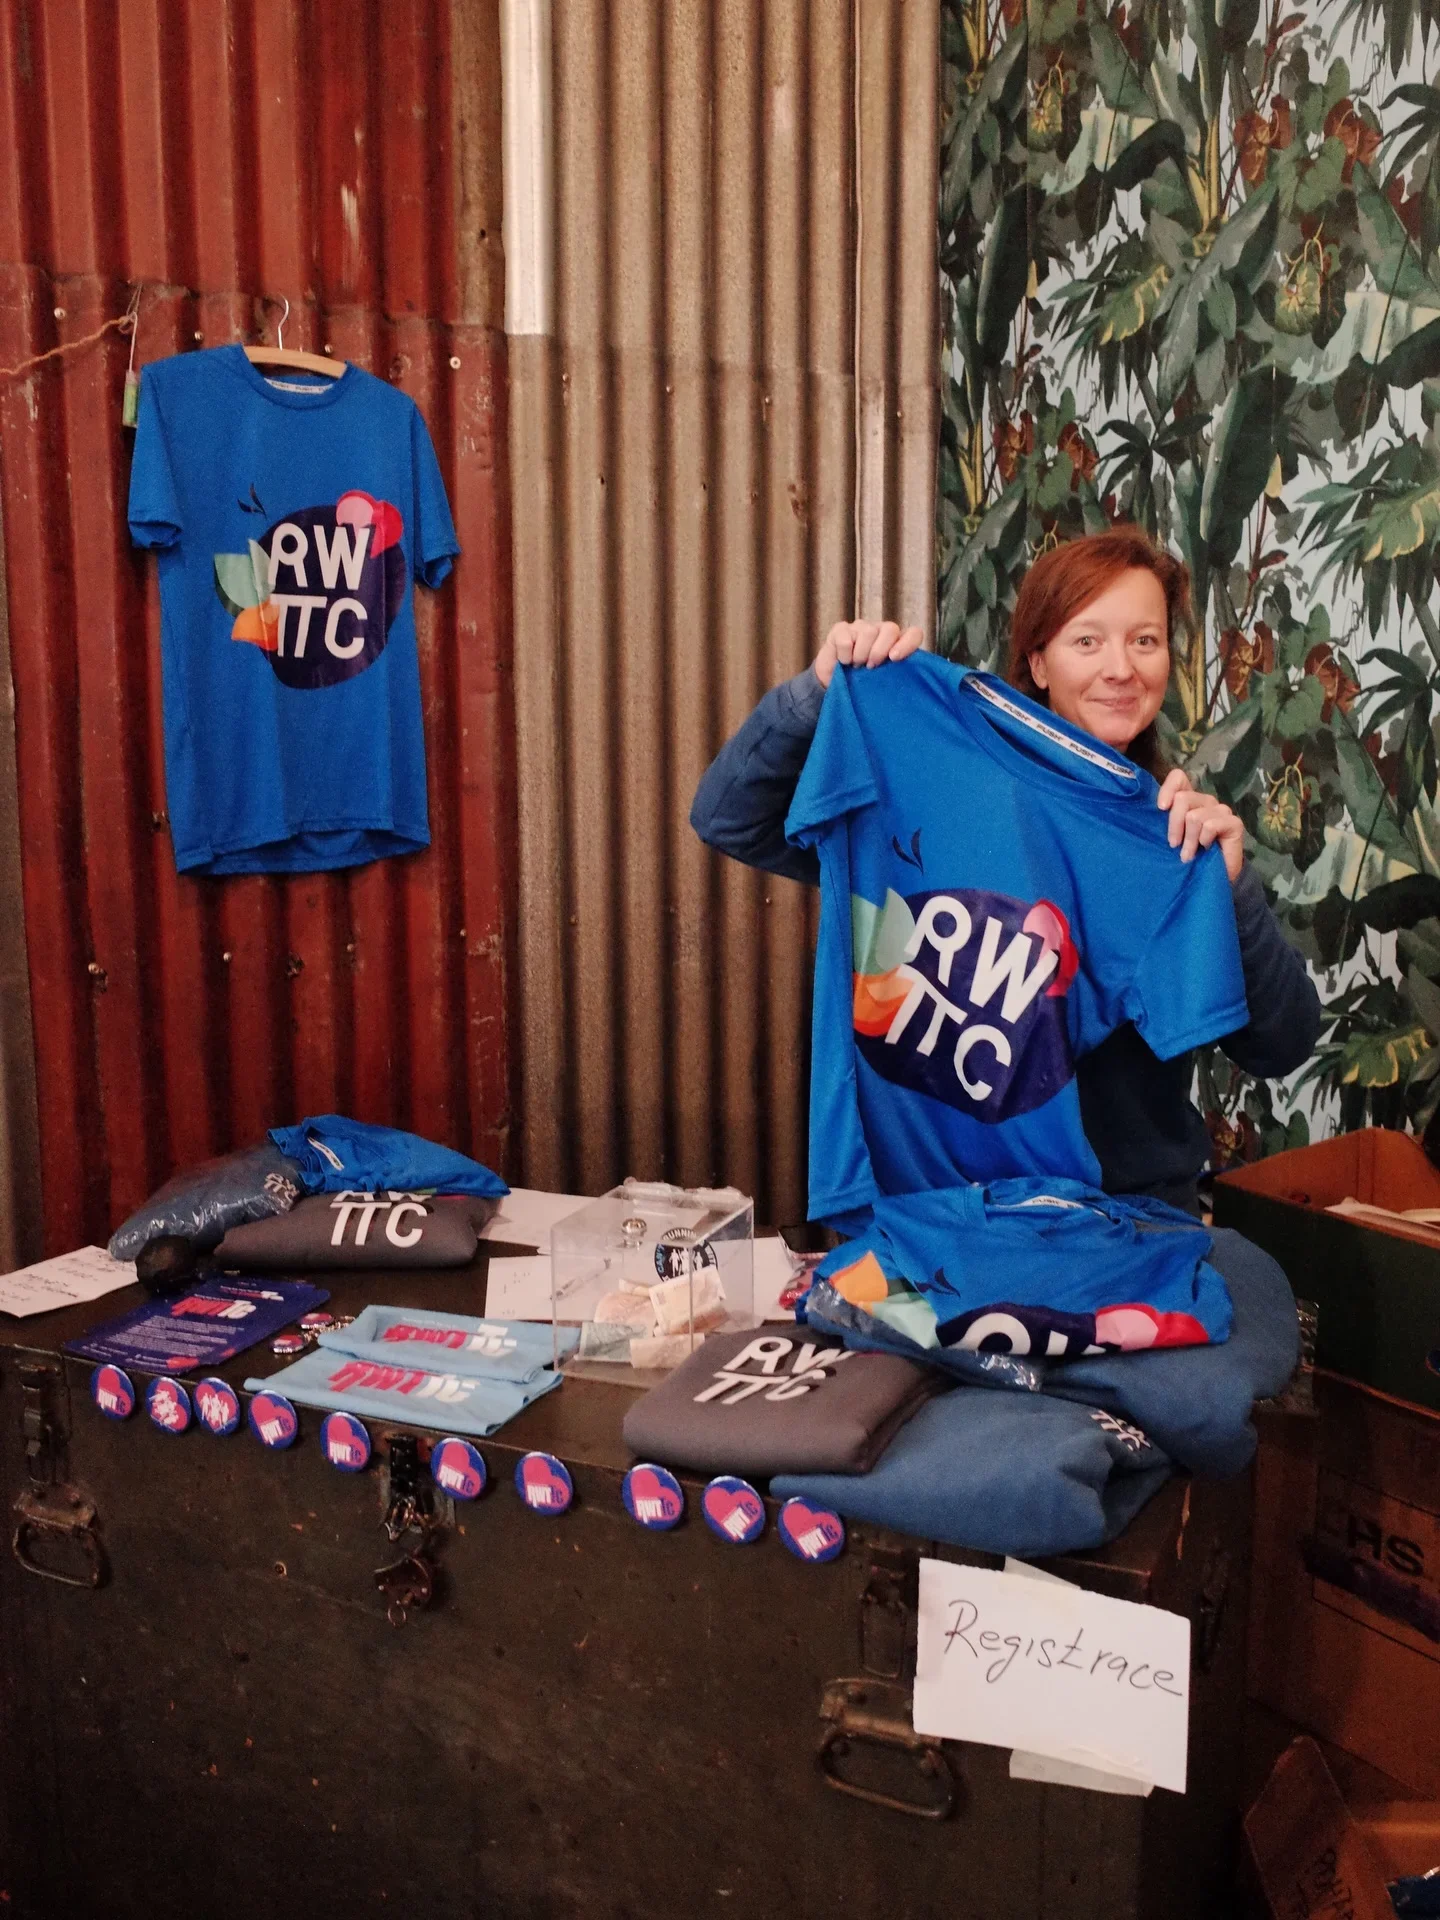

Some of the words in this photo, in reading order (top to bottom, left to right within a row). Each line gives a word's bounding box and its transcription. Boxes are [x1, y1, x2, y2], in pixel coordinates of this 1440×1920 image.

[267, 522, 371, 591] RW
[1003, 702, 1031, 722] PUSH
[1036, 723, 1063, 742] PUSH
[1069, 742, 1096, 760] PUSH
[904, 895, 1059, 1025] RW
[330, 1201, 428, 1248] TTC
[944, 1599, 1183, 1697] Registrace
